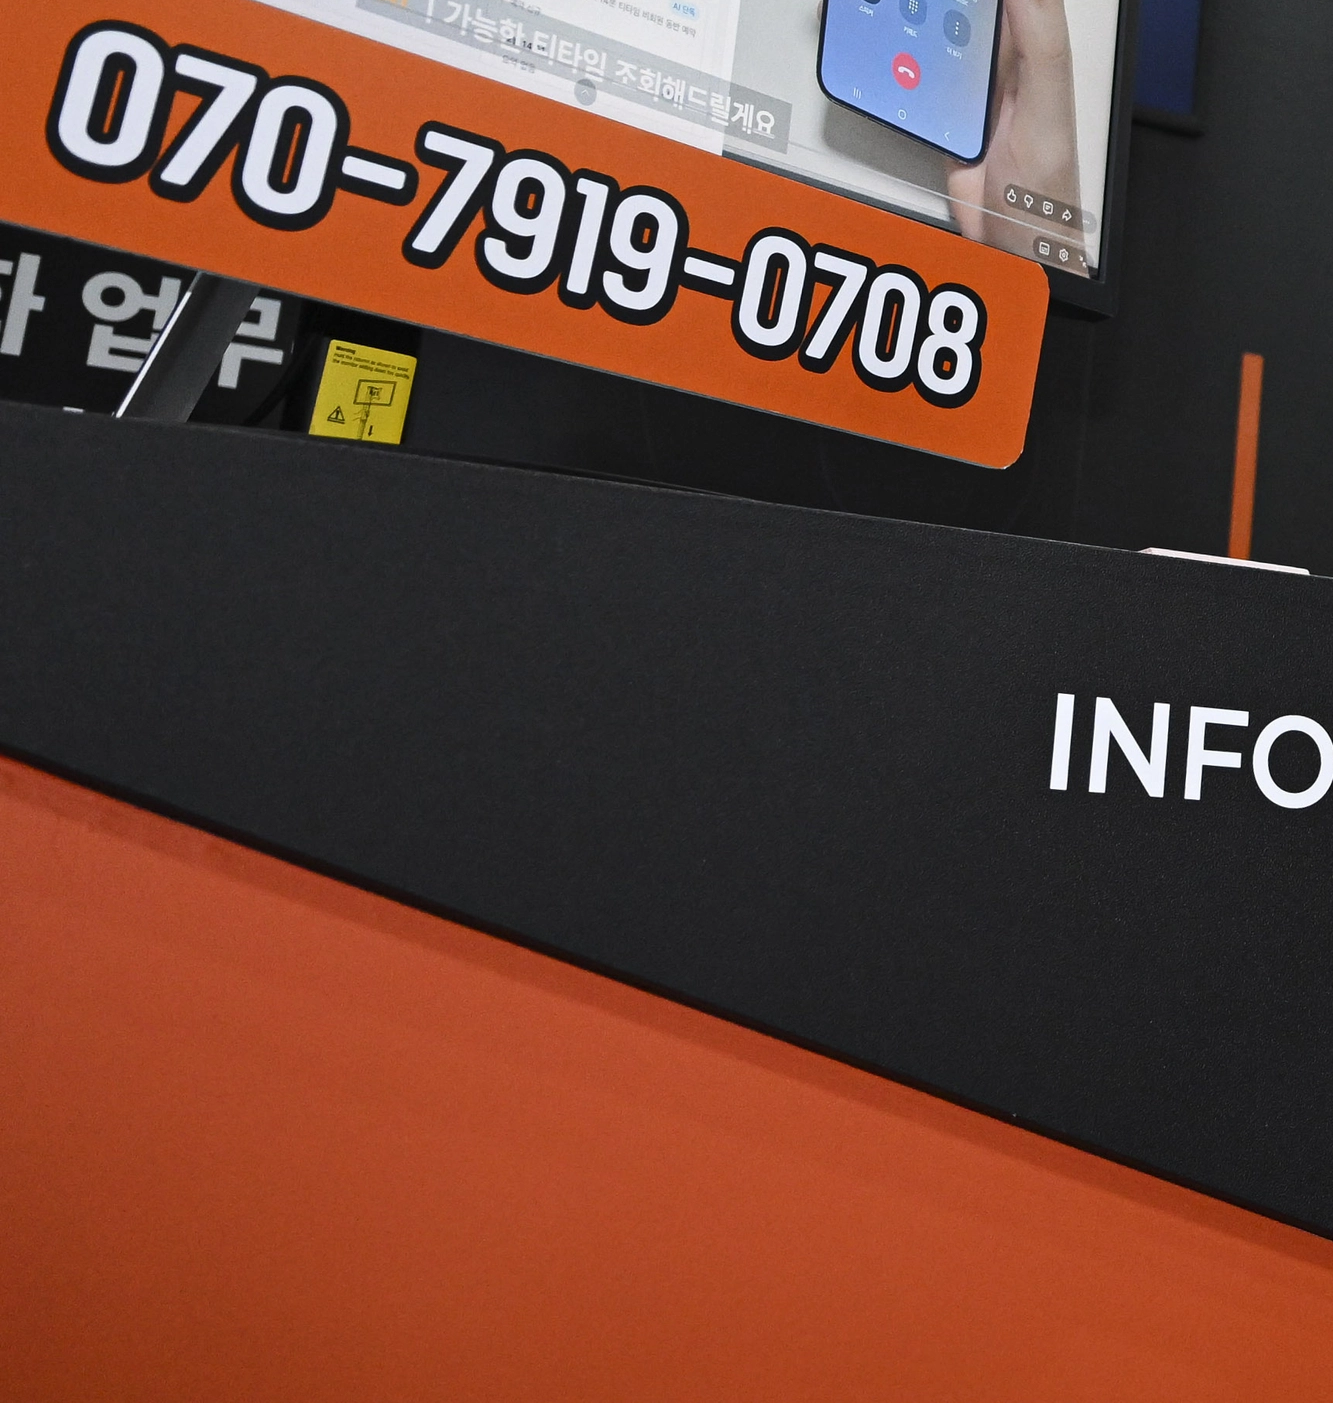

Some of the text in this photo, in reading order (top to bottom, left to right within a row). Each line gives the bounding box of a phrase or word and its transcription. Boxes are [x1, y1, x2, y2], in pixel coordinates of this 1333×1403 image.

[532, 29, 607, 77] 티타임
[613, 58, 777, 136] 조회해드릴게요
[58, 29, 982, 397] 070-7919-0708
